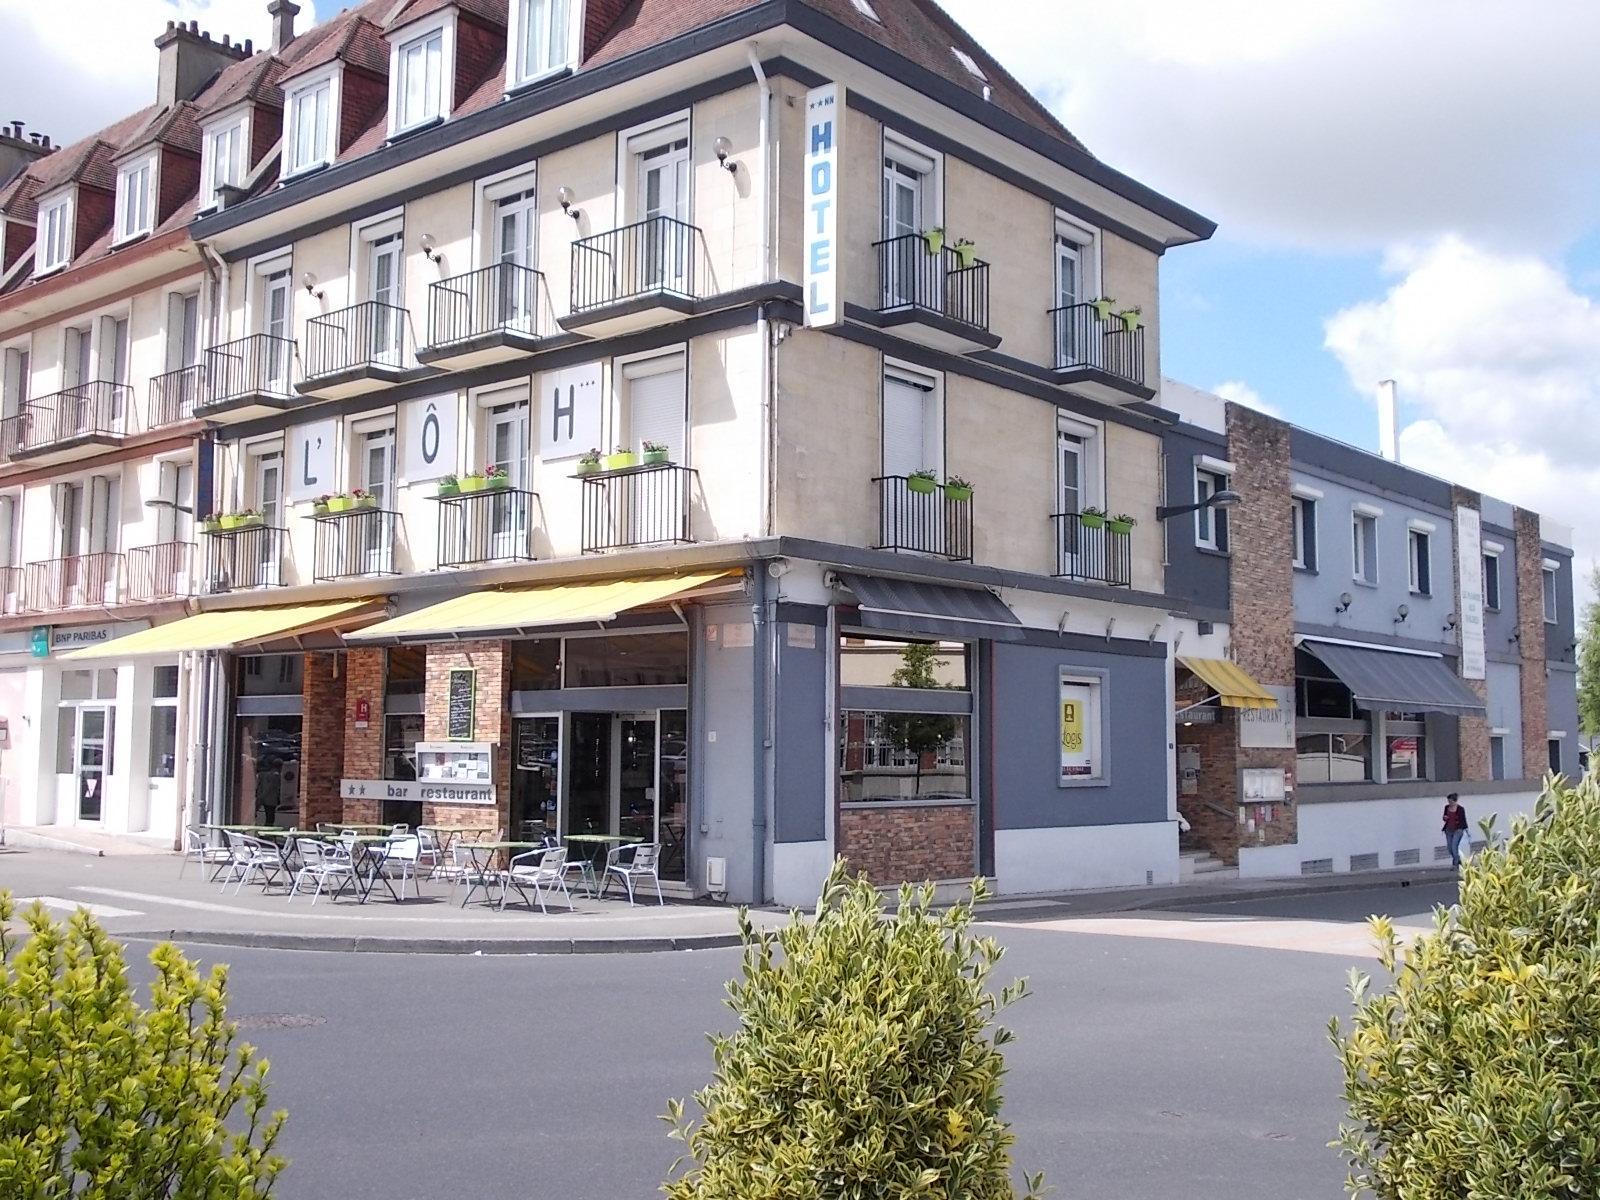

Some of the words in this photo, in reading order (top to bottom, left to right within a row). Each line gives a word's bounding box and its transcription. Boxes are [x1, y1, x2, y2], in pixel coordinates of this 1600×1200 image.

[810, 121, 831, 314] HOTEL
[422, 403, 440, 464] Ô
[553, 384, 575, 442] H
[56, 633, 72, 643] BNP
[73, 630, 107, 641] PARIBAS
[360, 703, 368, 713] H
[1242, 707, 1283, 723] RESTAURANT
[387, 784, 409, 798] bar
[420, 787, 492, 801] restaurant
